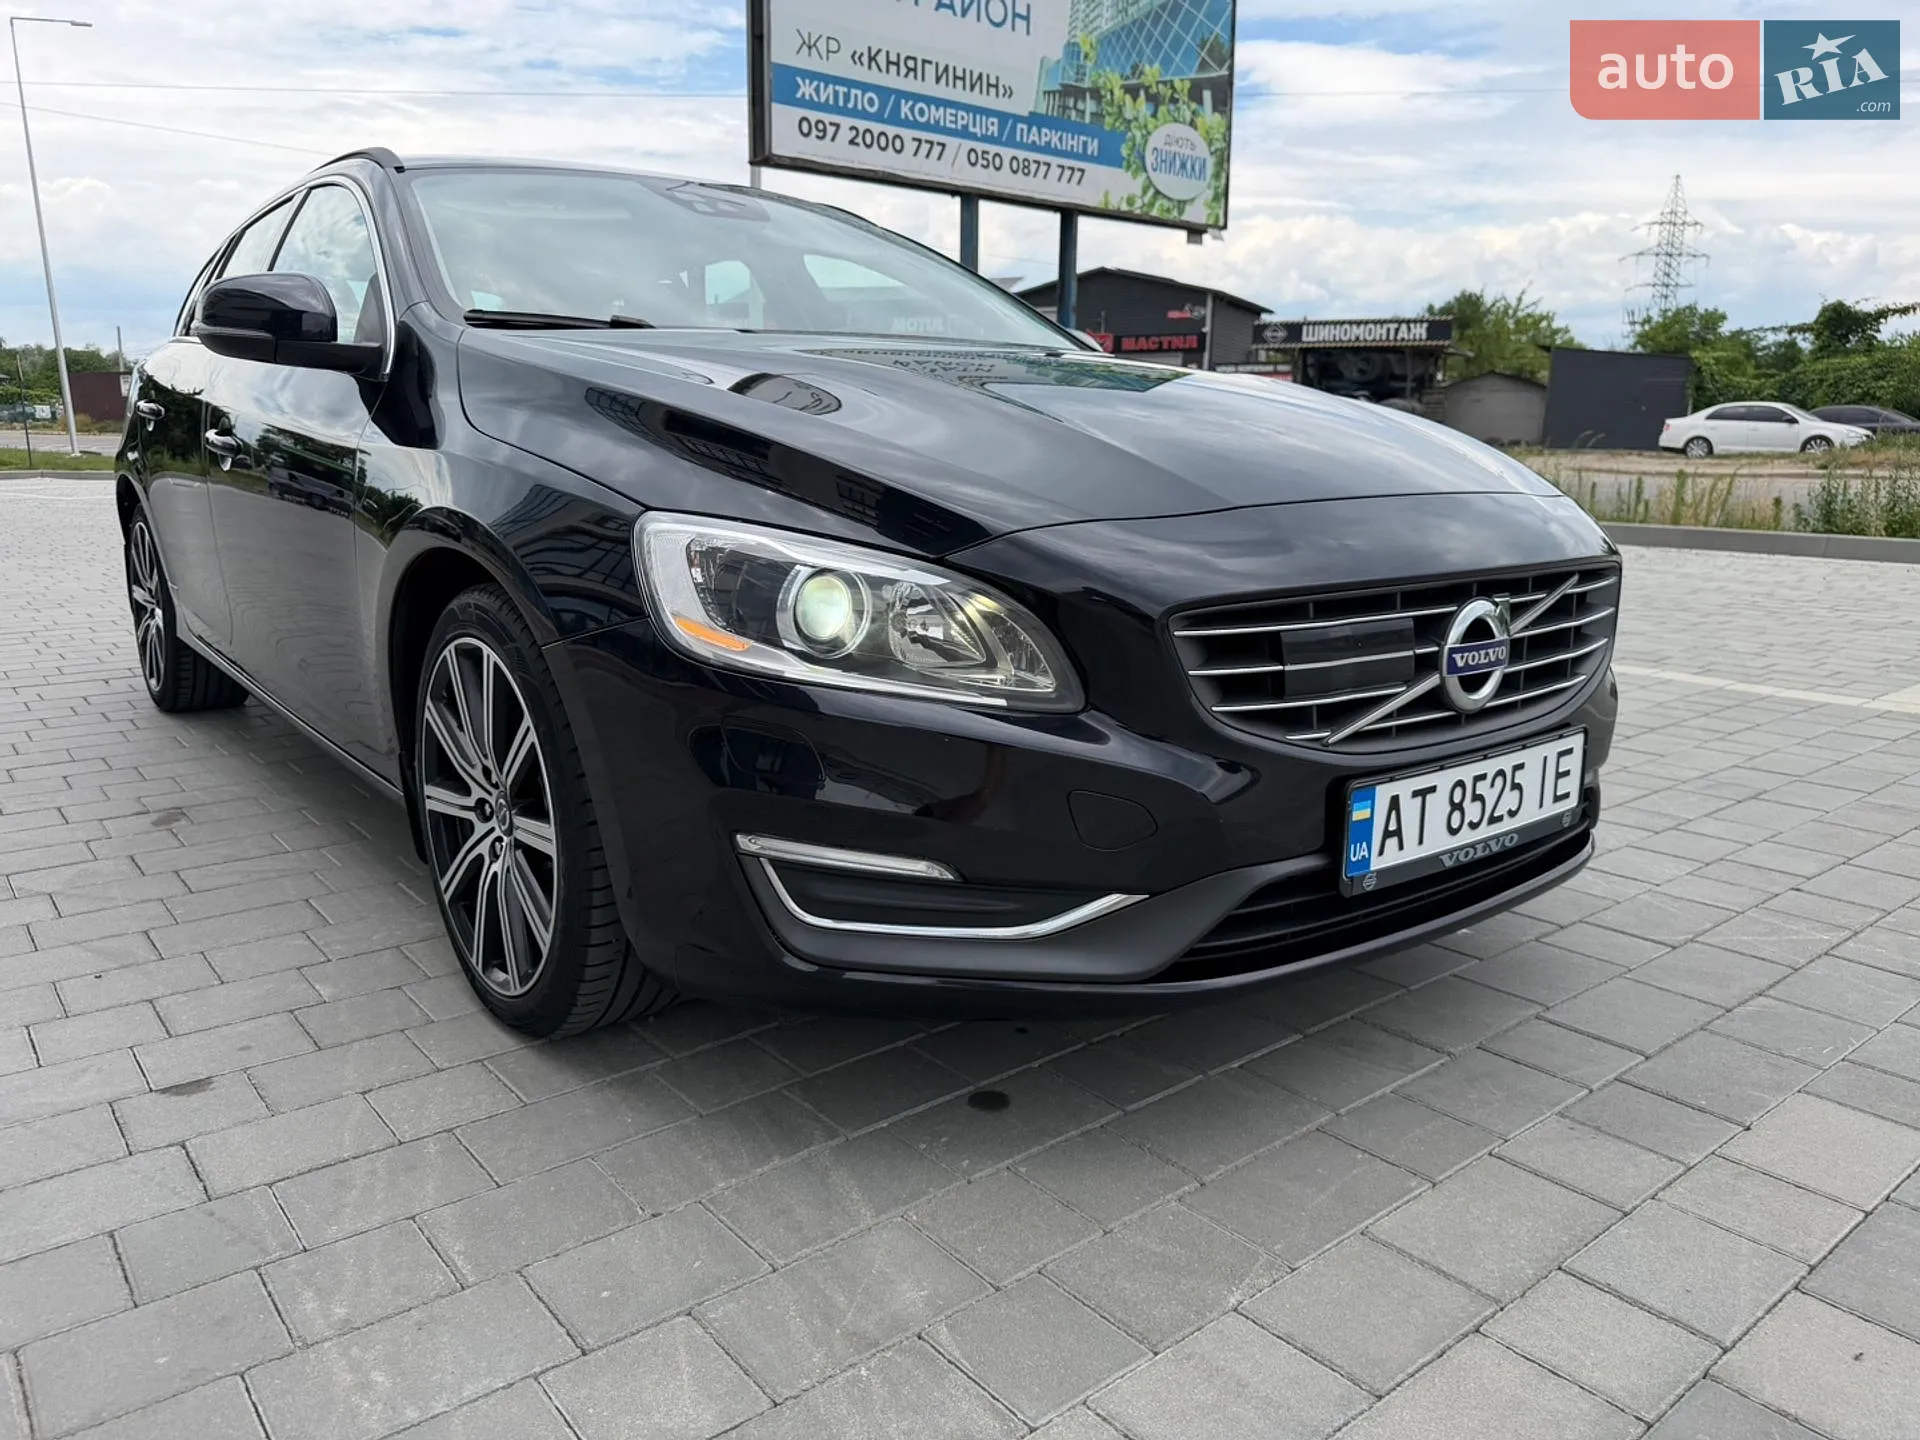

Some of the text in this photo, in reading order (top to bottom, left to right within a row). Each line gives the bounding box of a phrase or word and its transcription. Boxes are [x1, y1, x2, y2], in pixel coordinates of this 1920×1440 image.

[796, 28, 1014, 99] ЖР «КНЯГИНИН»
[795, 76, 879, 113] ЖИТЛО
[900, 99, 999, 138] КОМЕРЦІЯ
[1015, 123, 1099, 157] ПАРКІНГИ
[798, 116, 841, 143] 097
[848, 126, 905, 154] 2000
[911, 137, 947, 161] 777
[967, 148, 1003, 172] 050
[1009, 156, 1052, 180] 0877
[1056, 164, 1086, 186] 777
[1151, 147, 1207, 182] ЗНИЖКИ
[1301, 322, 1429, 343] ШИНОМОНТАЖ
[1452, 646, 1506, 668] VOLVO
[1376, 747, 1575, 857] AT 8525 IE
[1350, 841, 1369, 862] UA
[1440, 833, 1519, 869] VOLVO
